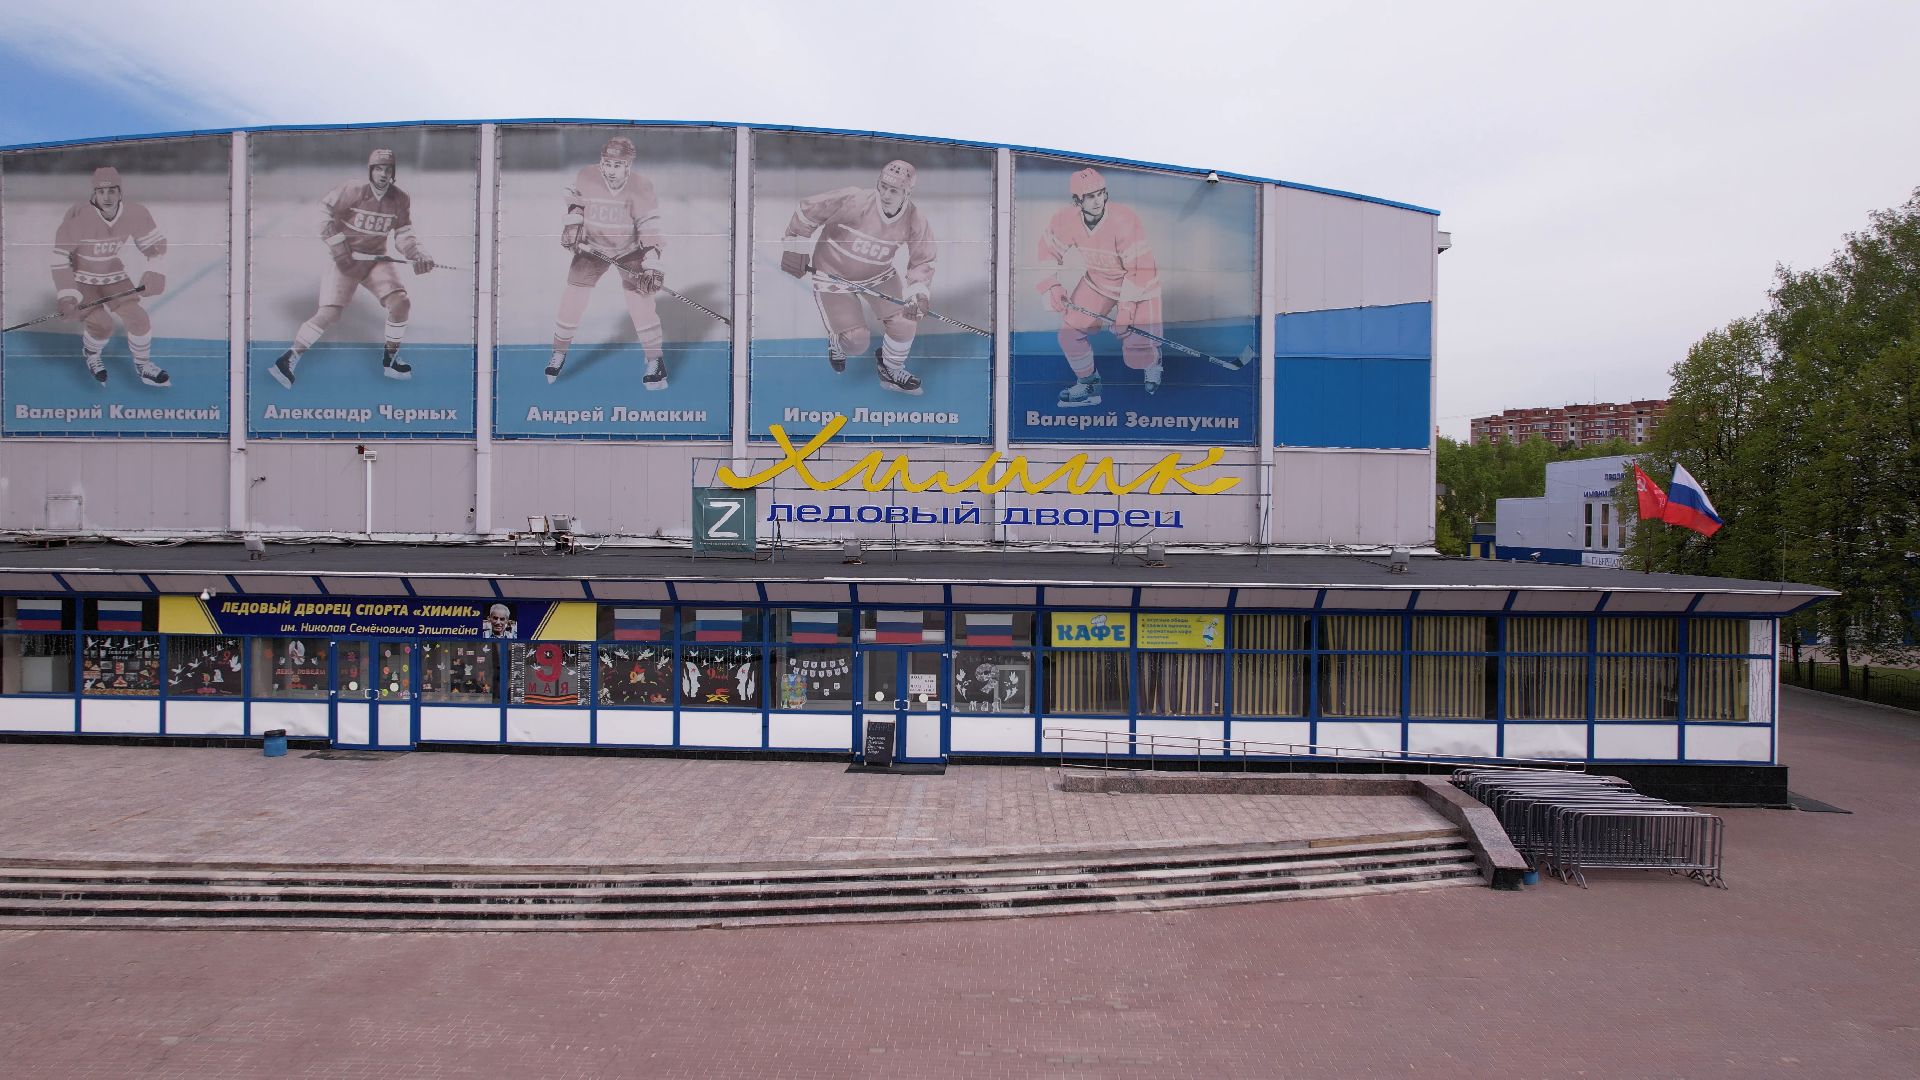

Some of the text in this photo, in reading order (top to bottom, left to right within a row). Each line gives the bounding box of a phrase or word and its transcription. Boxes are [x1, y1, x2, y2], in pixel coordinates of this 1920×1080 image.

[851, 238, 890, 260] СССР
[15, 404, 220, 422] Валерий Каменский
[263, 404, 458, 424] Александр Черных
[526, 406, 707, 424] Андрей Ломакин
[852, 407, 959, 427] Ларионов
[1026, 410, 1240, 432] Валерий Зелепукин
[707, 501, 741, 537] Z
[766, 501, 1184, 533] ледовый дворец
[221, 601, 481, 617] ЛЕДОВЫЙ ДВОРЕЦ СПОРТА «ХИМИК»
[280, 623, 479, 636] им. Николая Семёновича Эпштейна
[1056, 624, 1126, 641] КАФЕ
[536, 643, 563, 682] 9
[528, 682, 569, 694] МАЯ
